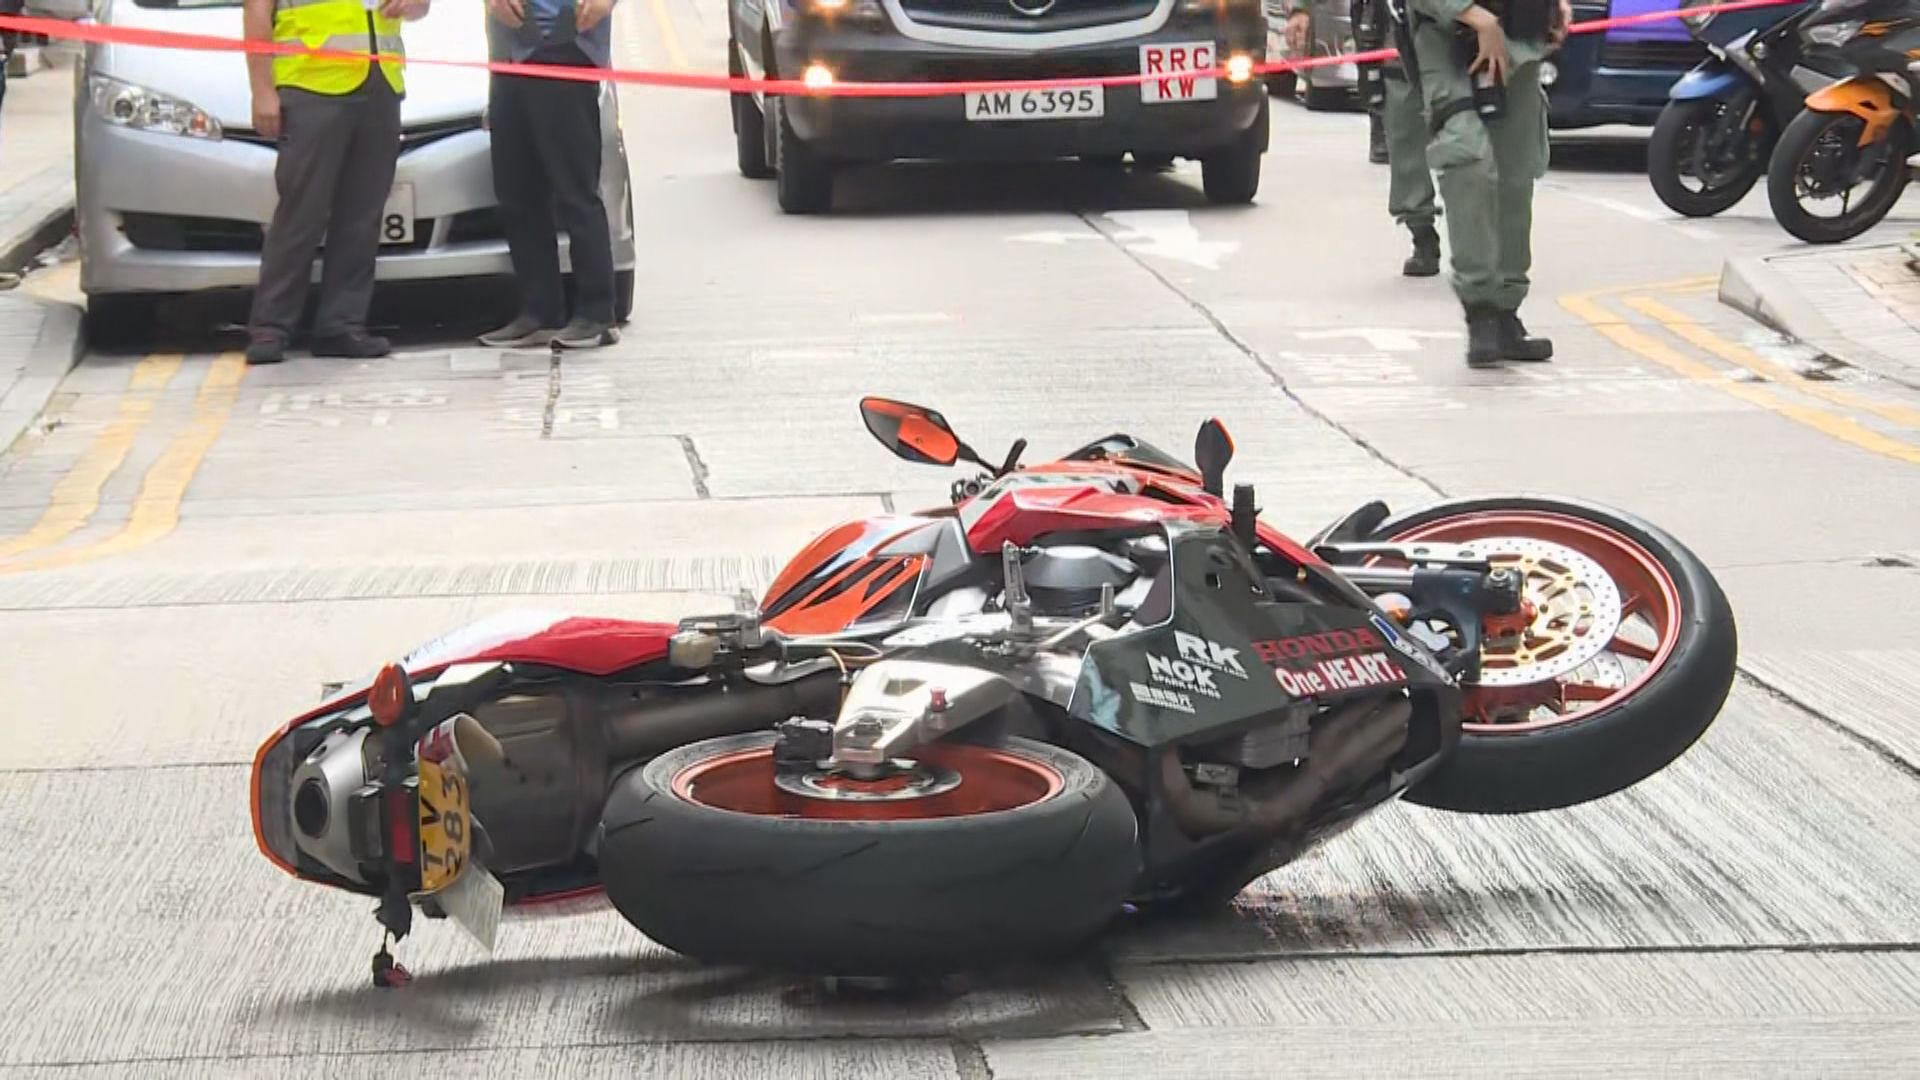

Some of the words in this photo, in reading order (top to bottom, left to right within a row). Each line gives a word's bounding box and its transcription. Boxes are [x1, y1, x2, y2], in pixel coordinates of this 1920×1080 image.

[1146, 48, 1210, 73] RRC
[976, 92, 1011, 116] AM
[1021, 90, 1094, 113] 6395
[1158, 77, 1196, 99] KW
[1174, 630, 1246, 674] RK
[1251, 627, 1383, 663] HONDA
[1146, 652, 1218, 690] NGK
[1275, 667, 1326, 697] One
[1318, 652, 1407, 690] HEART.
[421, 794, 444, 872] TV
[441, 771, 463, 878] 283
